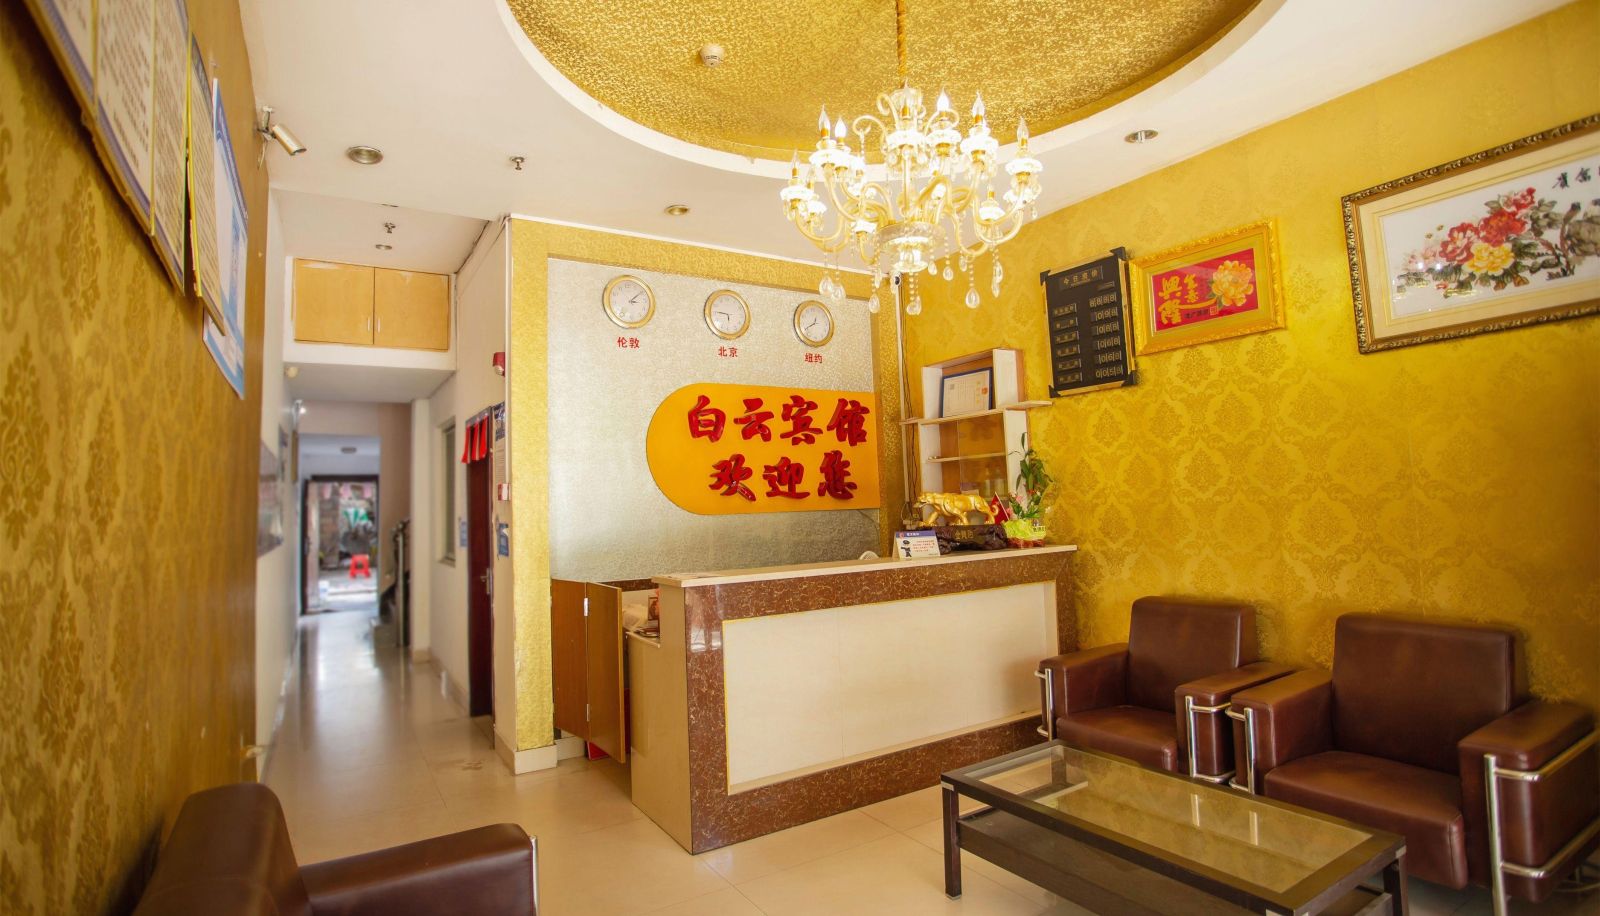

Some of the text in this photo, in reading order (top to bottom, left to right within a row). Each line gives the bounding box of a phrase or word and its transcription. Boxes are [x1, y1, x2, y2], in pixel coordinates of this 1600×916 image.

[617, 336, 640, 349] 伦敦
[718, 346, 738, 358] 北京
[804, 353, 823, 364] 纽约
[688, 395, 870, 447] 白云宾馆
[709, 450, 857, 502] 欢迎您
